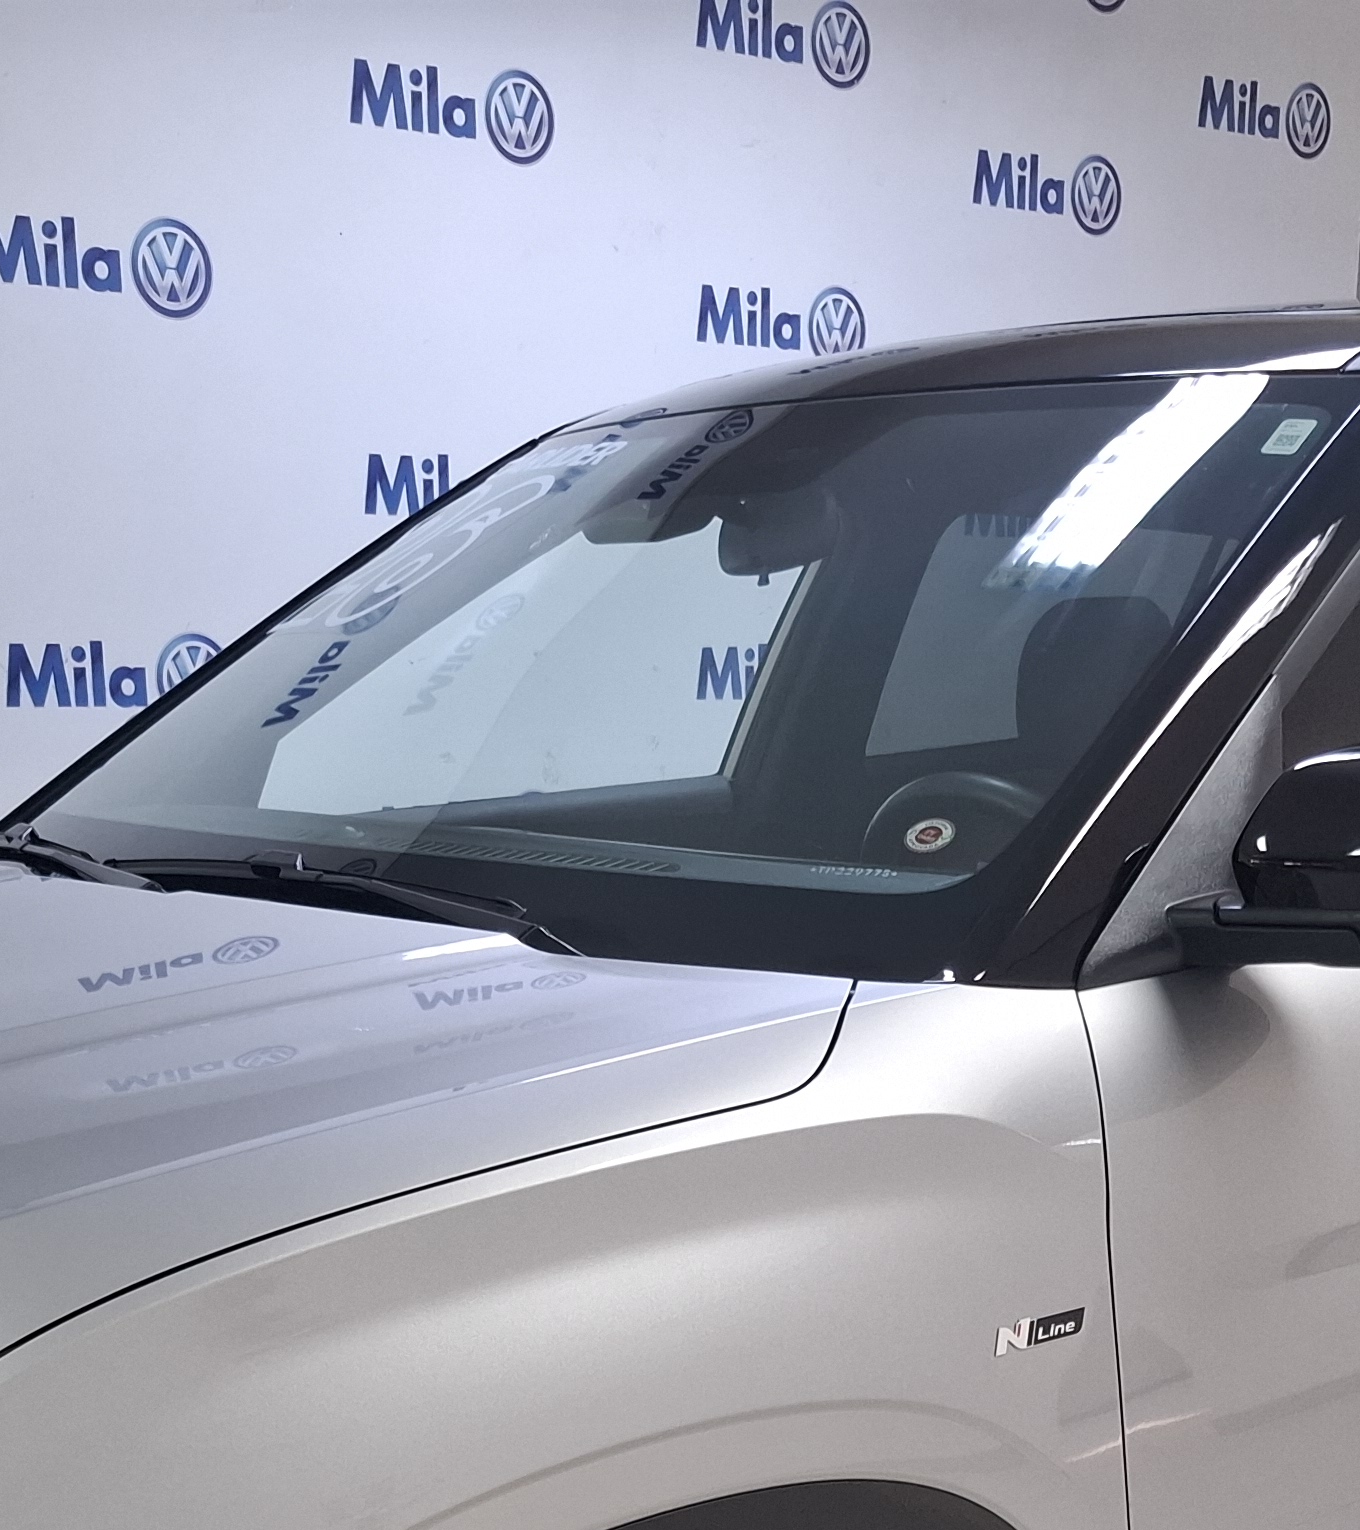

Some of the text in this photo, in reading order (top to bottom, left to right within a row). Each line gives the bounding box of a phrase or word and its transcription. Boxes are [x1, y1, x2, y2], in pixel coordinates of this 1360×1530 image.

[696, 0, 803, 64] Mila
[350, 58, 476, 139] Mila
[1198, 76, 1280, 139] Mila
[973, 150, 1064, 215] Mila
[697, 285, 800, 350] Mila
[6, 641, 148, 707] Mila
[1037, 1321, 1076, 1340] Line
